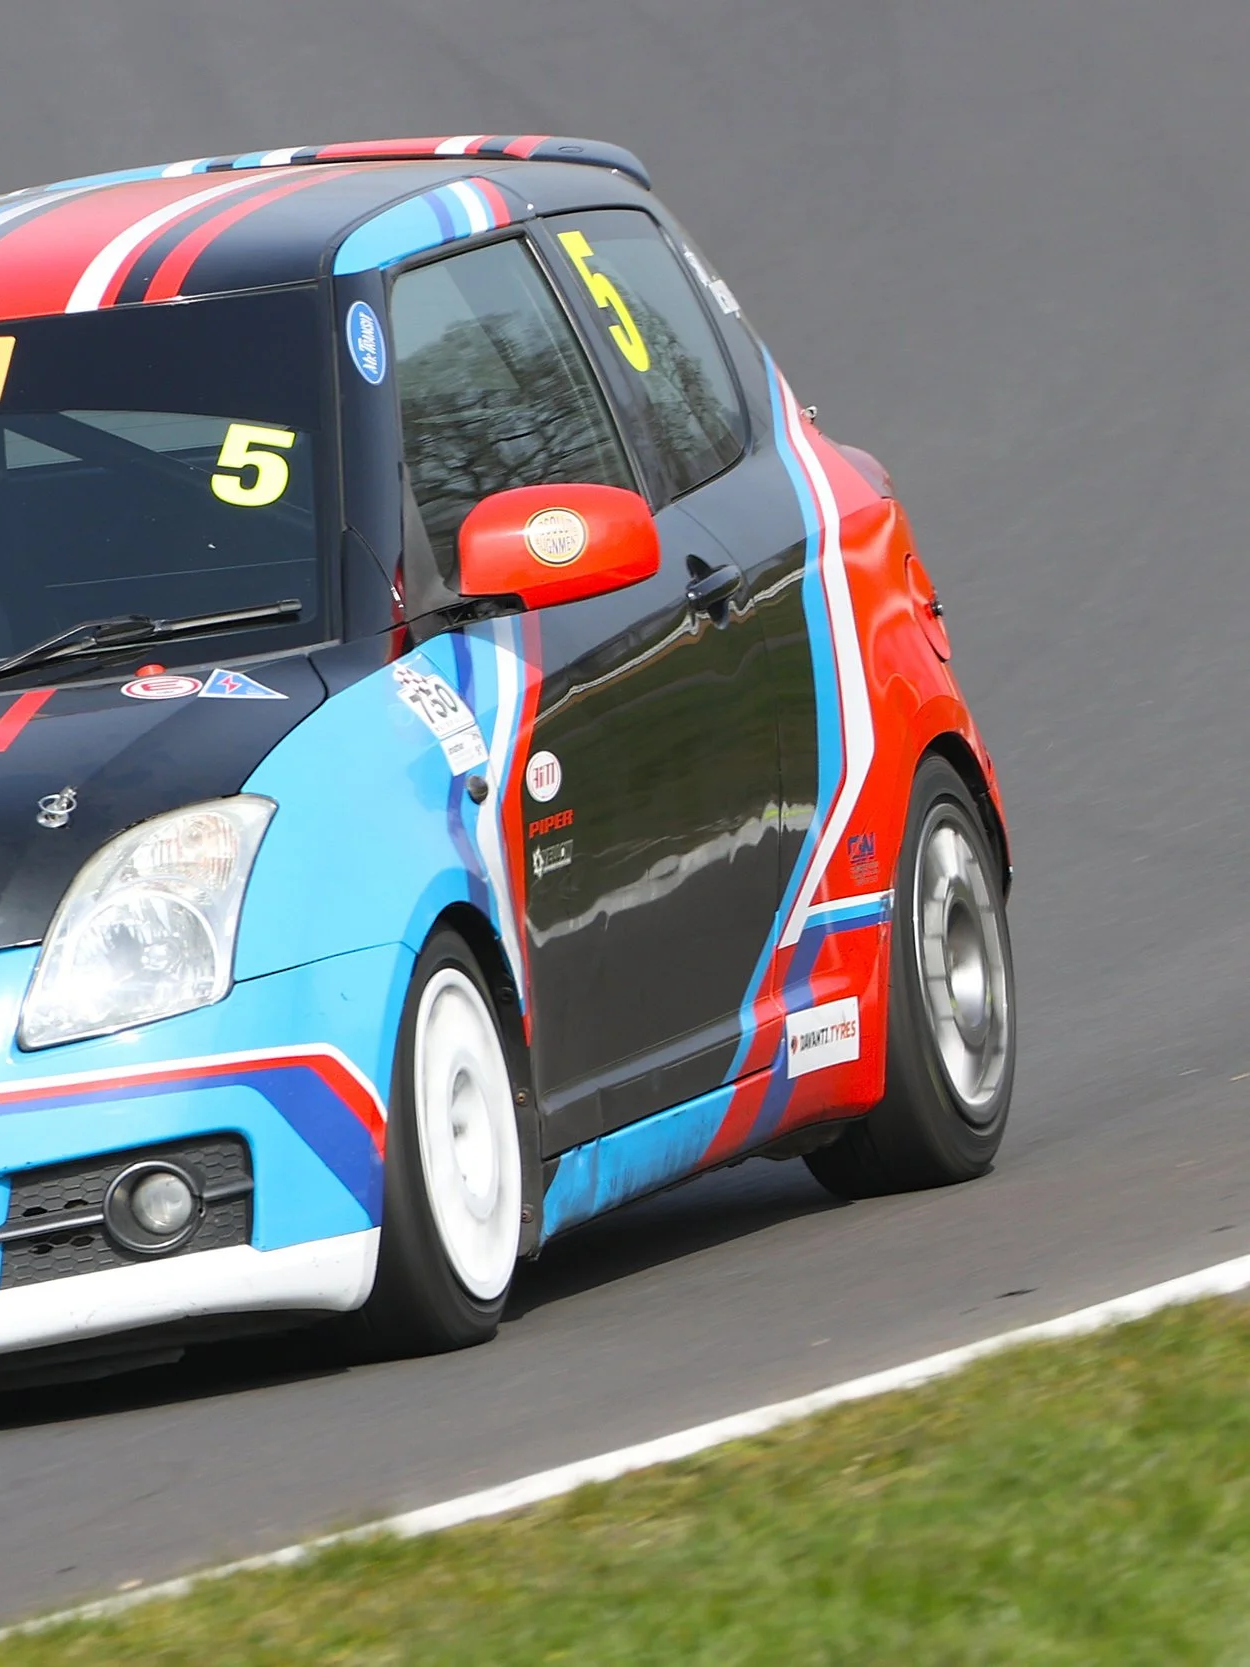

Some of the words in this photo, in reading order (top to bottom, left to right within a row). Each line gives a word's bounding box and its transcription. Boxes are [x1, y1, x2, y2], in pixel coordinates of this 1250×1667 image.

[557, 230, 649, 372] 5
[210, 422, 296, 507] 5
[409, 683, 458, 725] 750
[528, 808, 575, 839] PIPER
[830, 1019, 856, 1043] TYRES
